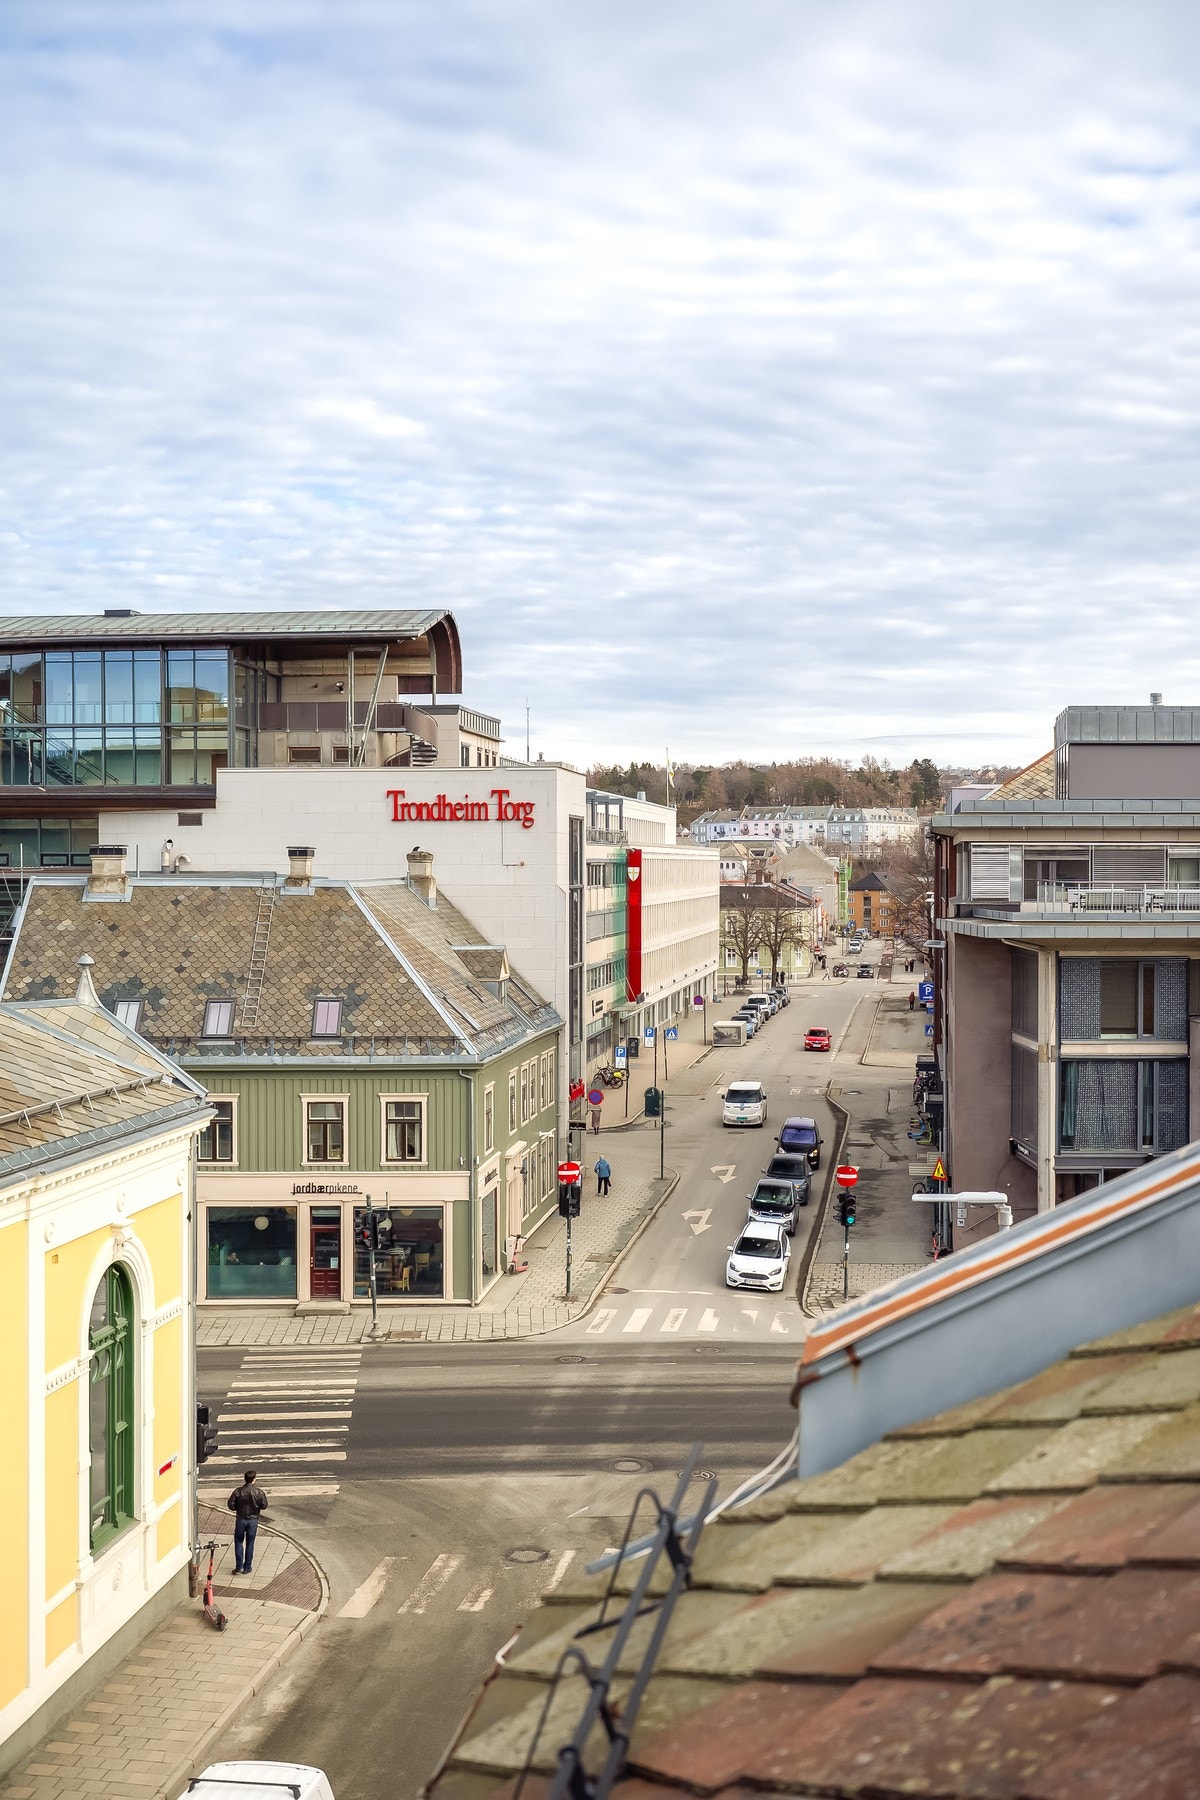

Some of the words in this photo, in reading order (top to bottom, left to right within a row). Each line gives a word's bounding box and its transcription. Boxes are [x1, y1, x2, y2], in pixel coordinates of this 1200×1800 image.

[386, 789, 489, 822] Trondheim
[491, 789, 535, 829] Torg
[925, 987, 932, 995] P
[617, 1048, 624, 1056] P
[292, 1182, 359, 1195] jordbærpikene
